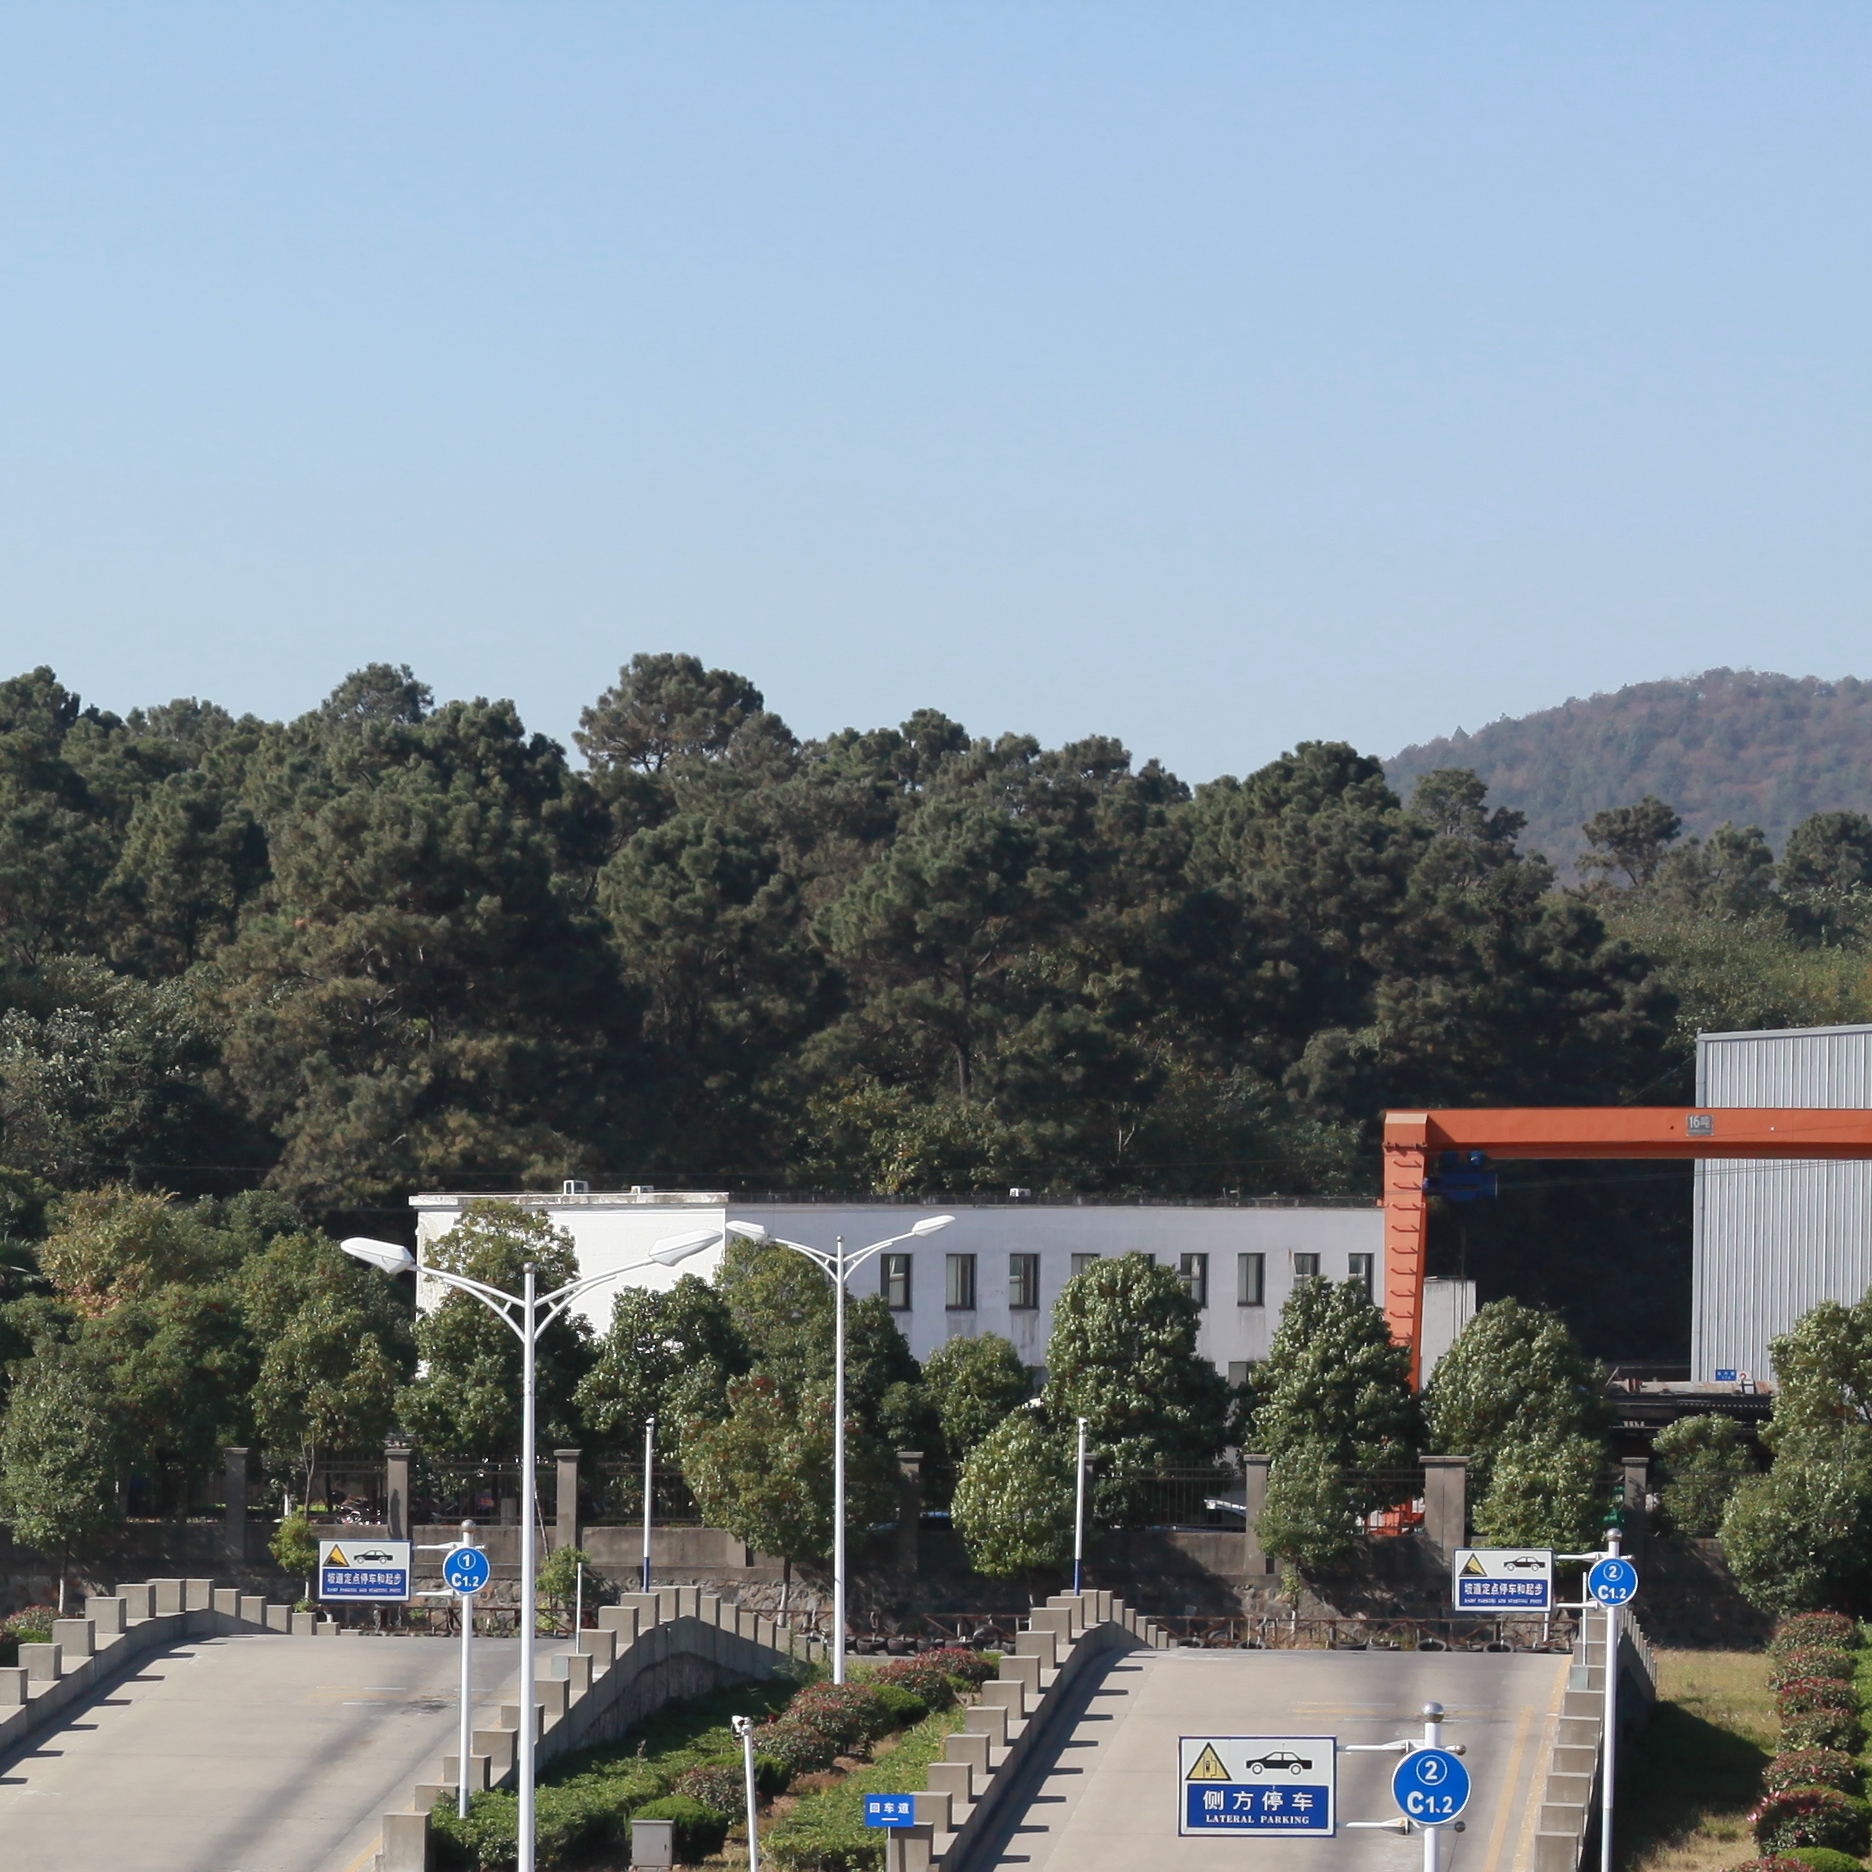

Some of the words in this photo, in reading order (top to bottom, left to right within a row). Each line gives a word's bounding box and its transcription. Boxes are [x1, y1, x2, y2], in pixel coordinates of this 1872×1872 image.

[869, 1802, 910, 1814] 回车道
[1202, 1790, 1314, 1812] 侧方停车
[1406, 1791, 1454, 1815] C1.2
[1206, 1814, 1255, 1824] LATERAL
[1260, 1815, 1310, 1825] PARKING
